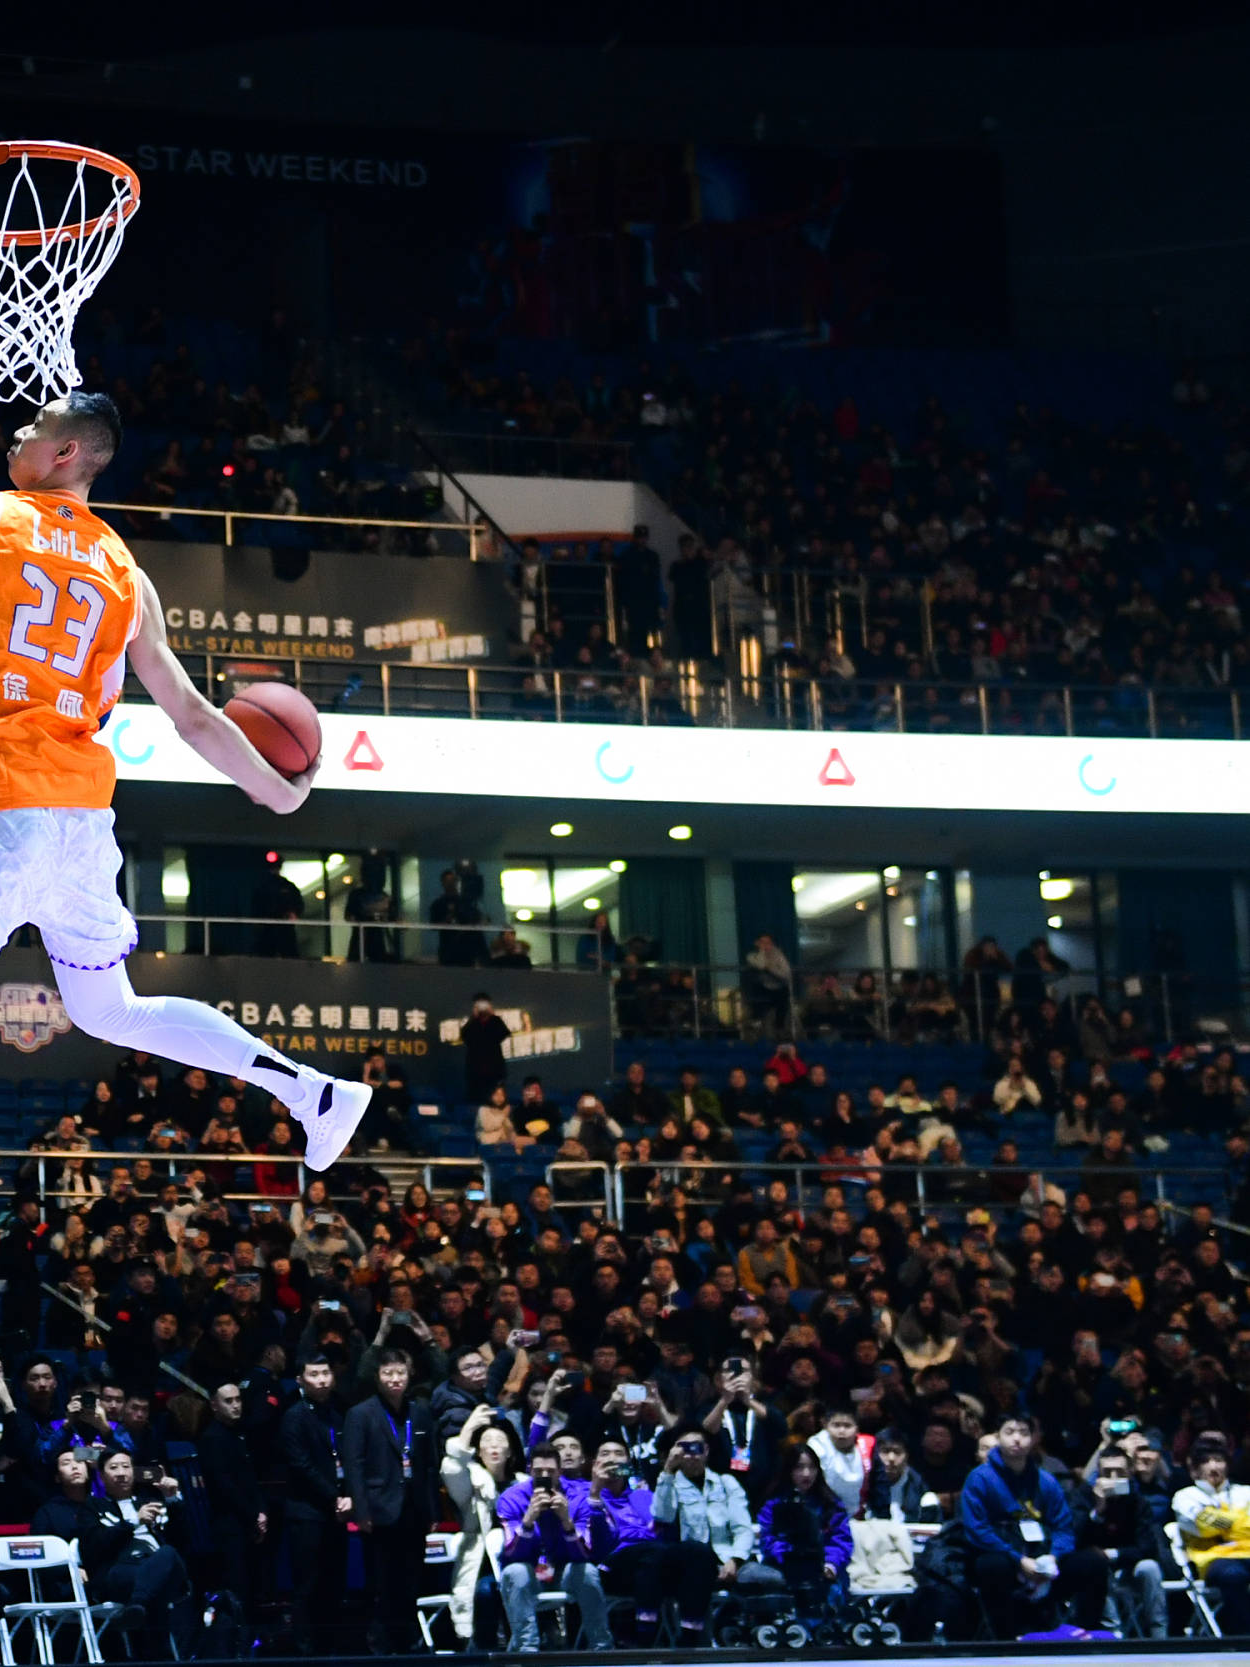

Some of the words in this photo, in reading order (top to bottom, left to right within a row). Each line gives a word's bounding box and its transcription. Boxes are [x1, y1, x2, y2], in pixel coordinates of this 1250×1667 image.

[245, 152, 429, 188] WEEKEND
[8, 562, 107, 678] 23
[261, 641, 355, 660] WEEKEND
